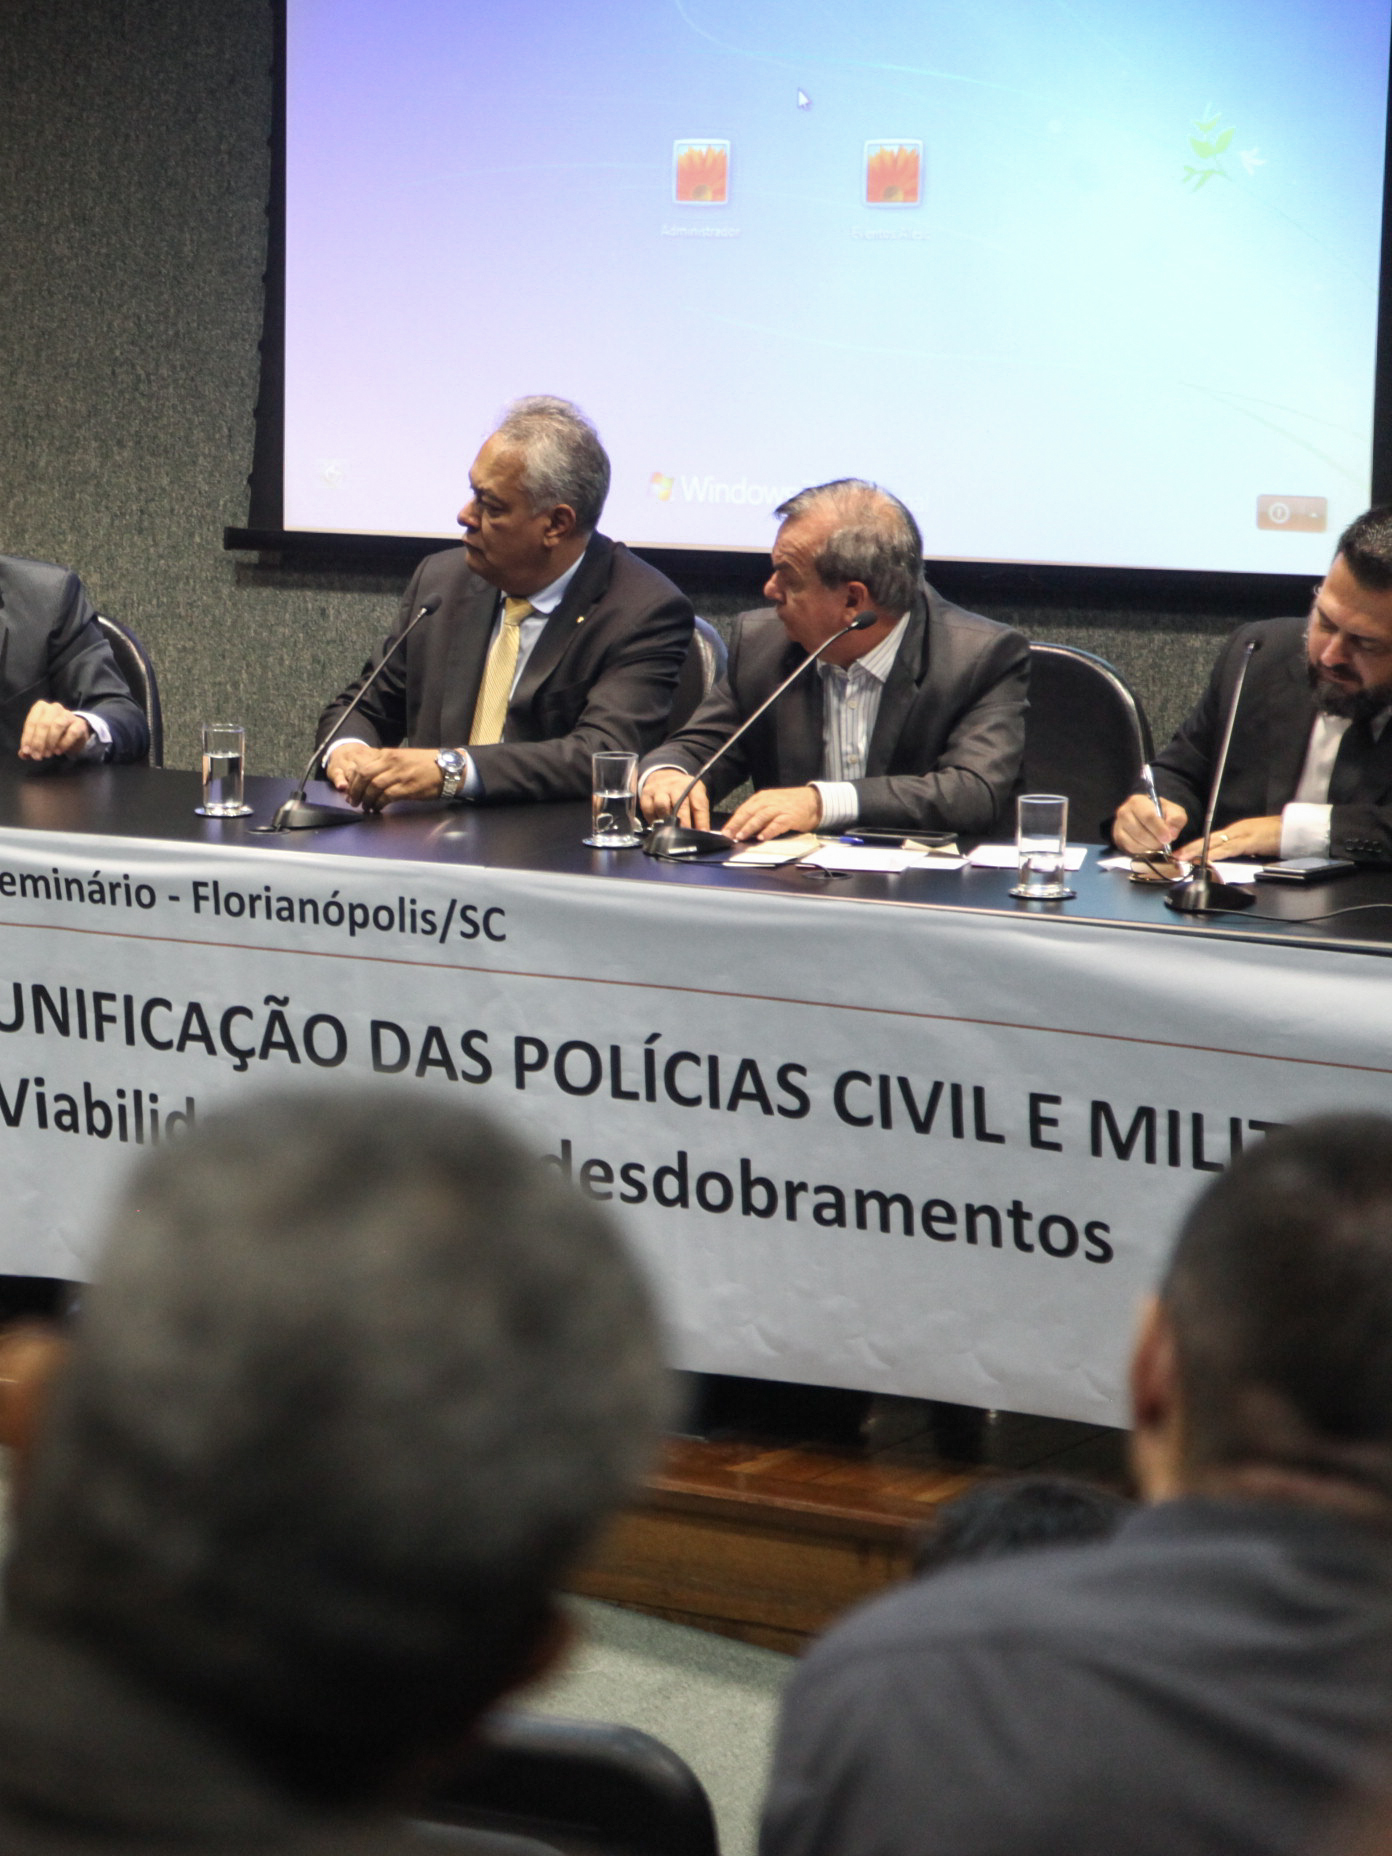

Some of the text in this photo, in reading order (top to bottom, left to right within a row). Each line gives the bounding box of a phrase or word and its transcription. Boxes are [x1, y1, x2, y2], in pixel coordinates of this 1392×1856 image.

[168, 894, 180, 902] -
[192, 879, 507, 944] Florianópolis/SC
[370, 1019, 493, 1085] DAS
[514, 1032, 811, 1120] POLÍCIAS
[833, 1070, 1006, 1145] CIVIL
[1028, 1092, 1063, 1153] E
[540, 1139, 1114, 1264] desdobramentos
